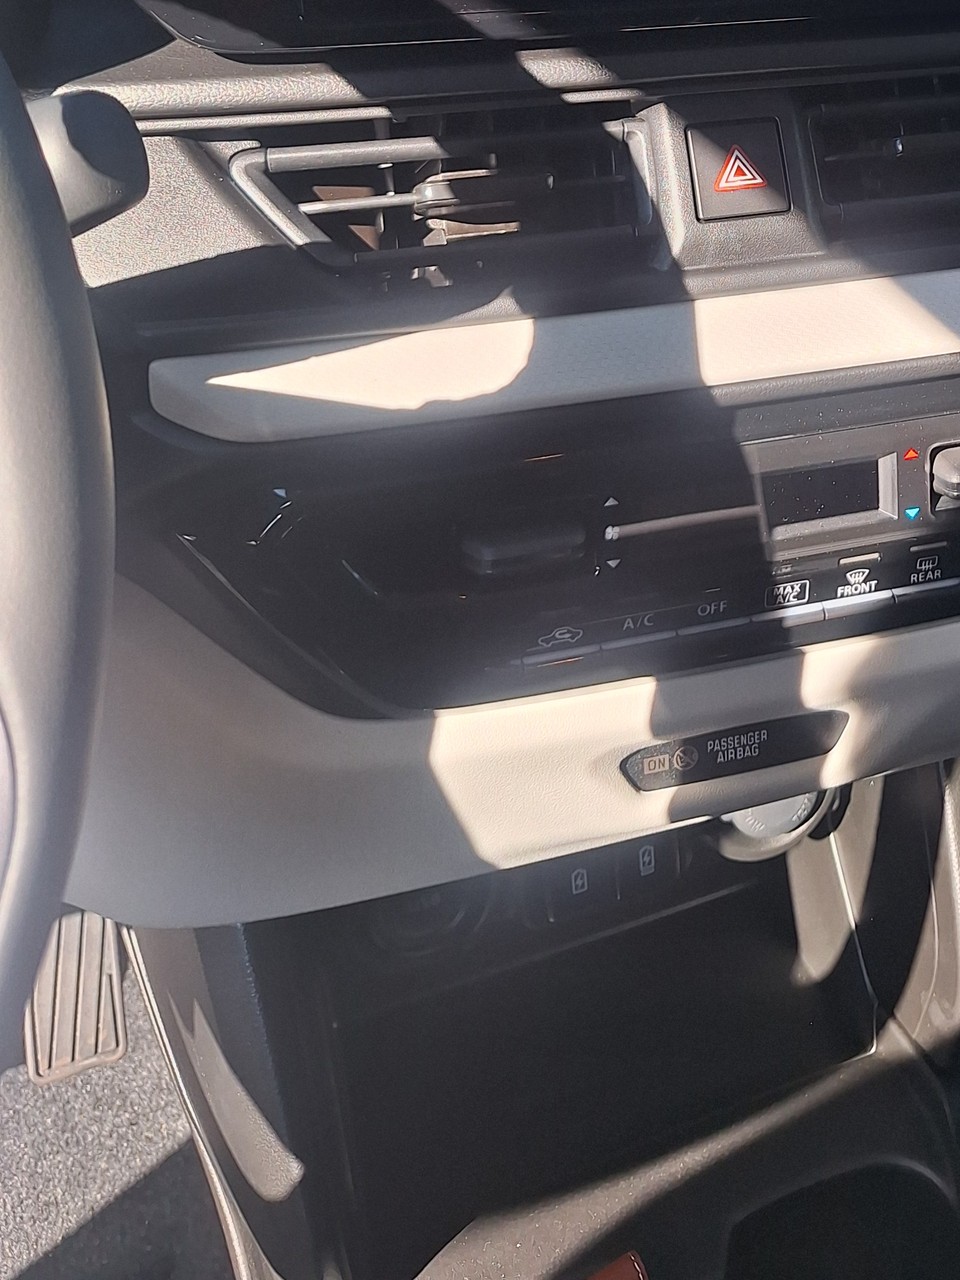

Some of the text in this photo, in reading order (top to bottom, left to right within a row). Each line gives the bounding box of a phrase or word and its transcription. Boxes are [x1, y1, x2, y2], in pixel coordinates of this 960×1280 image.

[910, 568, 942, 583] REAR
[773, 582, 801, 596] MAX
[836, 579, 878, 598] FRONT
[776, 592, 798, 605] A/C
[697, 600, 728, 617] OFF
[622, 613, 655, 631] A/C
[707, 729, 768, 753] PASSENGER
[716, 743, 760, 764] AIRBAG
[647, 757, 667, 771] ON
